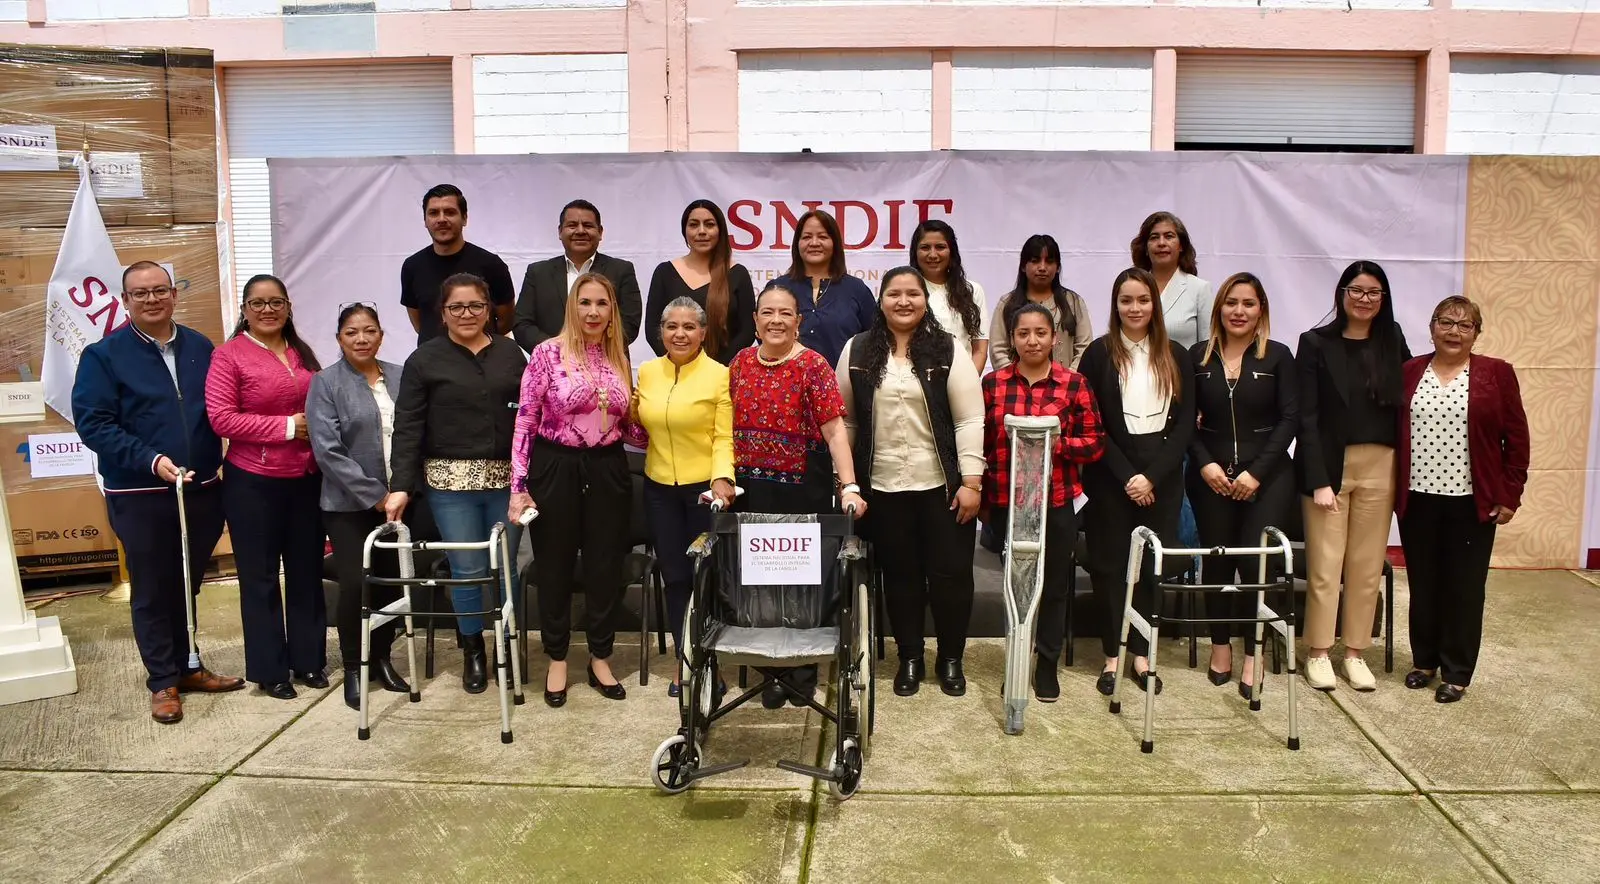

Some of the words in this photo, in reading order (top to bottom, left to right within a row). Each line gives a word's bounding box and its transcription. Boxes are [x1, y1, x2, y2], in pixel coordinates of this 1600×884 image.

[36, 442, 83, 455] SNDIF
[36, 531, 60, 541] FDA
[80, 528, 99, 537] ISO
[749, 537, 812, 552] SNDIF
